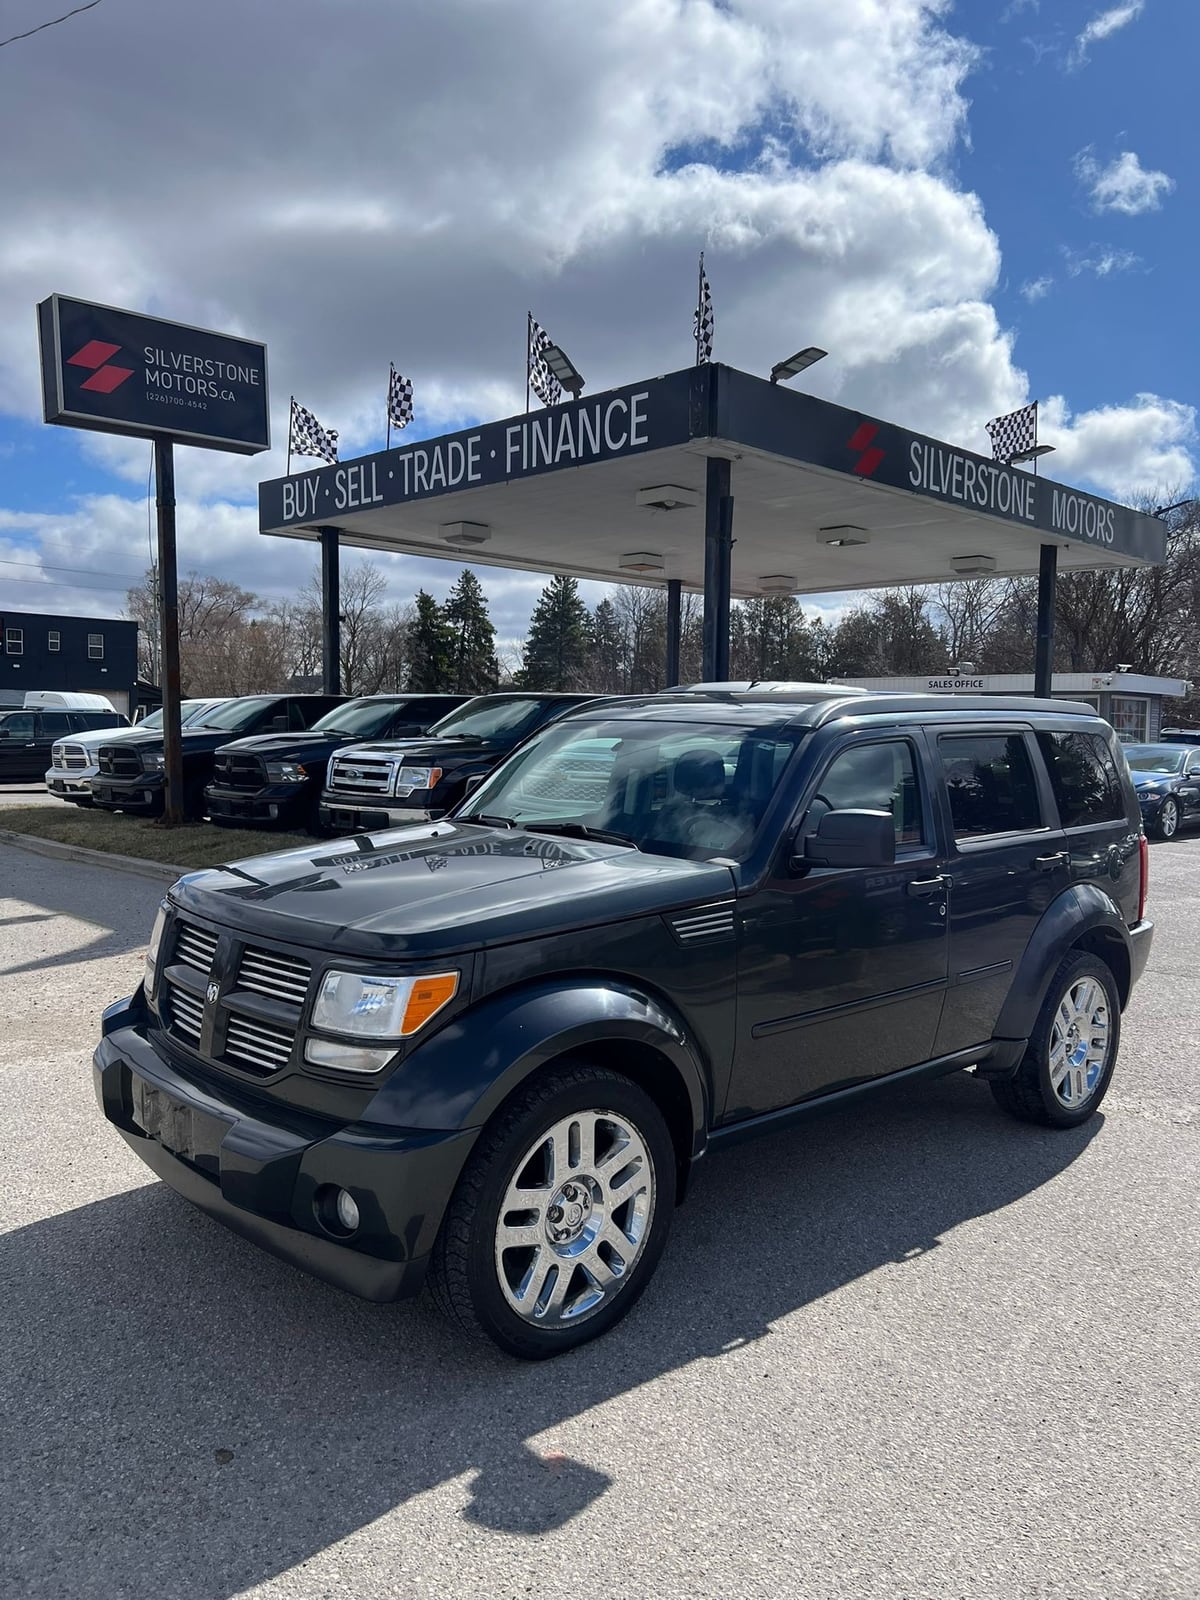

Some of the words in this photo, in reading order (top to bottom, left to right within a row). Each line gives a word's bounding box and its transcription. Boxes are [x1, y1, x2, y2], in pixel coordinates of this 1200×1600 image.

[144, 346, 259, 385] SILVERSTONE
[282, 475, 320, 520] BUY
[334, 462, 383, 509] SELL
[400, 435, 482, 495] TRADE
[505, 391, 649, 473] FINANCE
[909, 440, 1036, 521] SILVERSTONE
[1051, 489, 1115, 544] MOTORS
[928, 680, 953, 689] SALES
[954, 679, 984, 688] OFFICE
